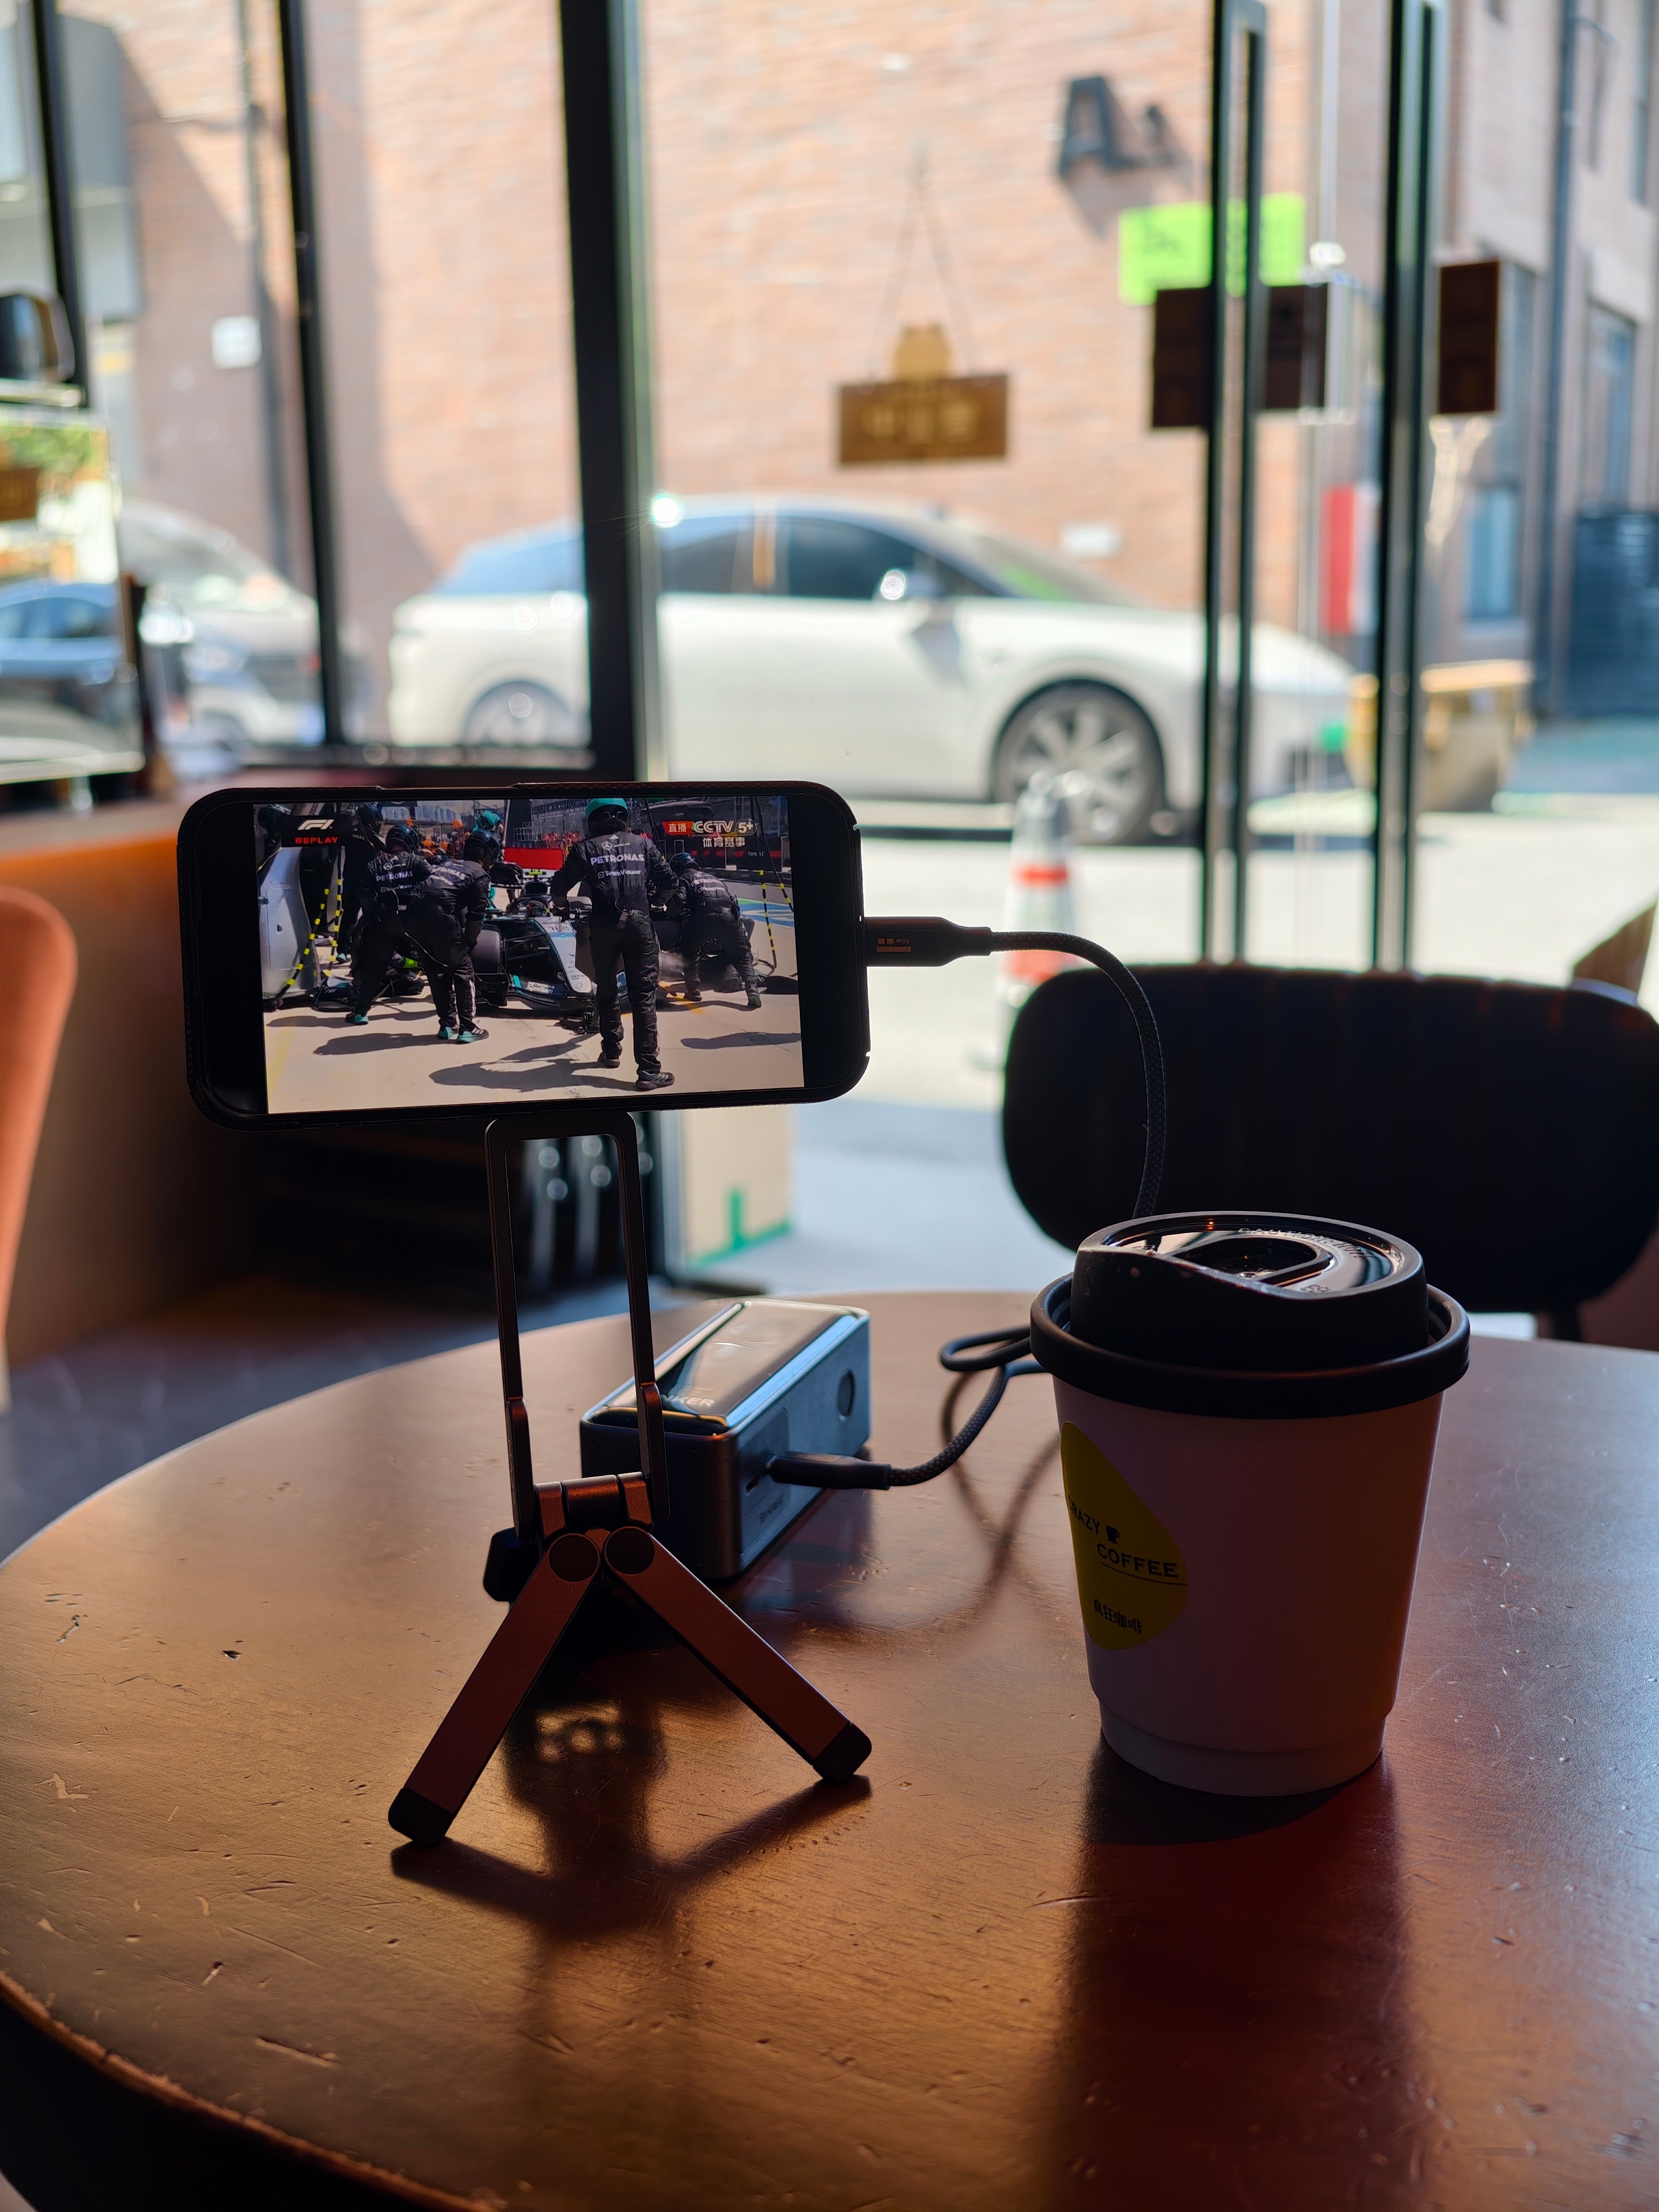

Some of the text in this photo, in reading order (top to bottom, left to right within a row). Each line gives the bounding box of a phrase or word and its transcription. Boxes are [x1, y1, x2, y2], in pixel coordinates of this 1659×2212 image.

[668, 822, 687, 833] 直播
[694, 820, 734, 833] CCTV
[294, 836, 339, 845] REPLAY
[702, 837, 746, 848] 体育赛事
[590, 853, 645, 866] PETRONAS
[375, 871, 414, 883] PETRONAS
[604, 868, 642, 877] TeamViewer
[660, 1394, 716, 1408] NKER
[1068, 1494, 1101, 1535] CRAZY
[1097, 1543, 1179, 1579] COFFEE
